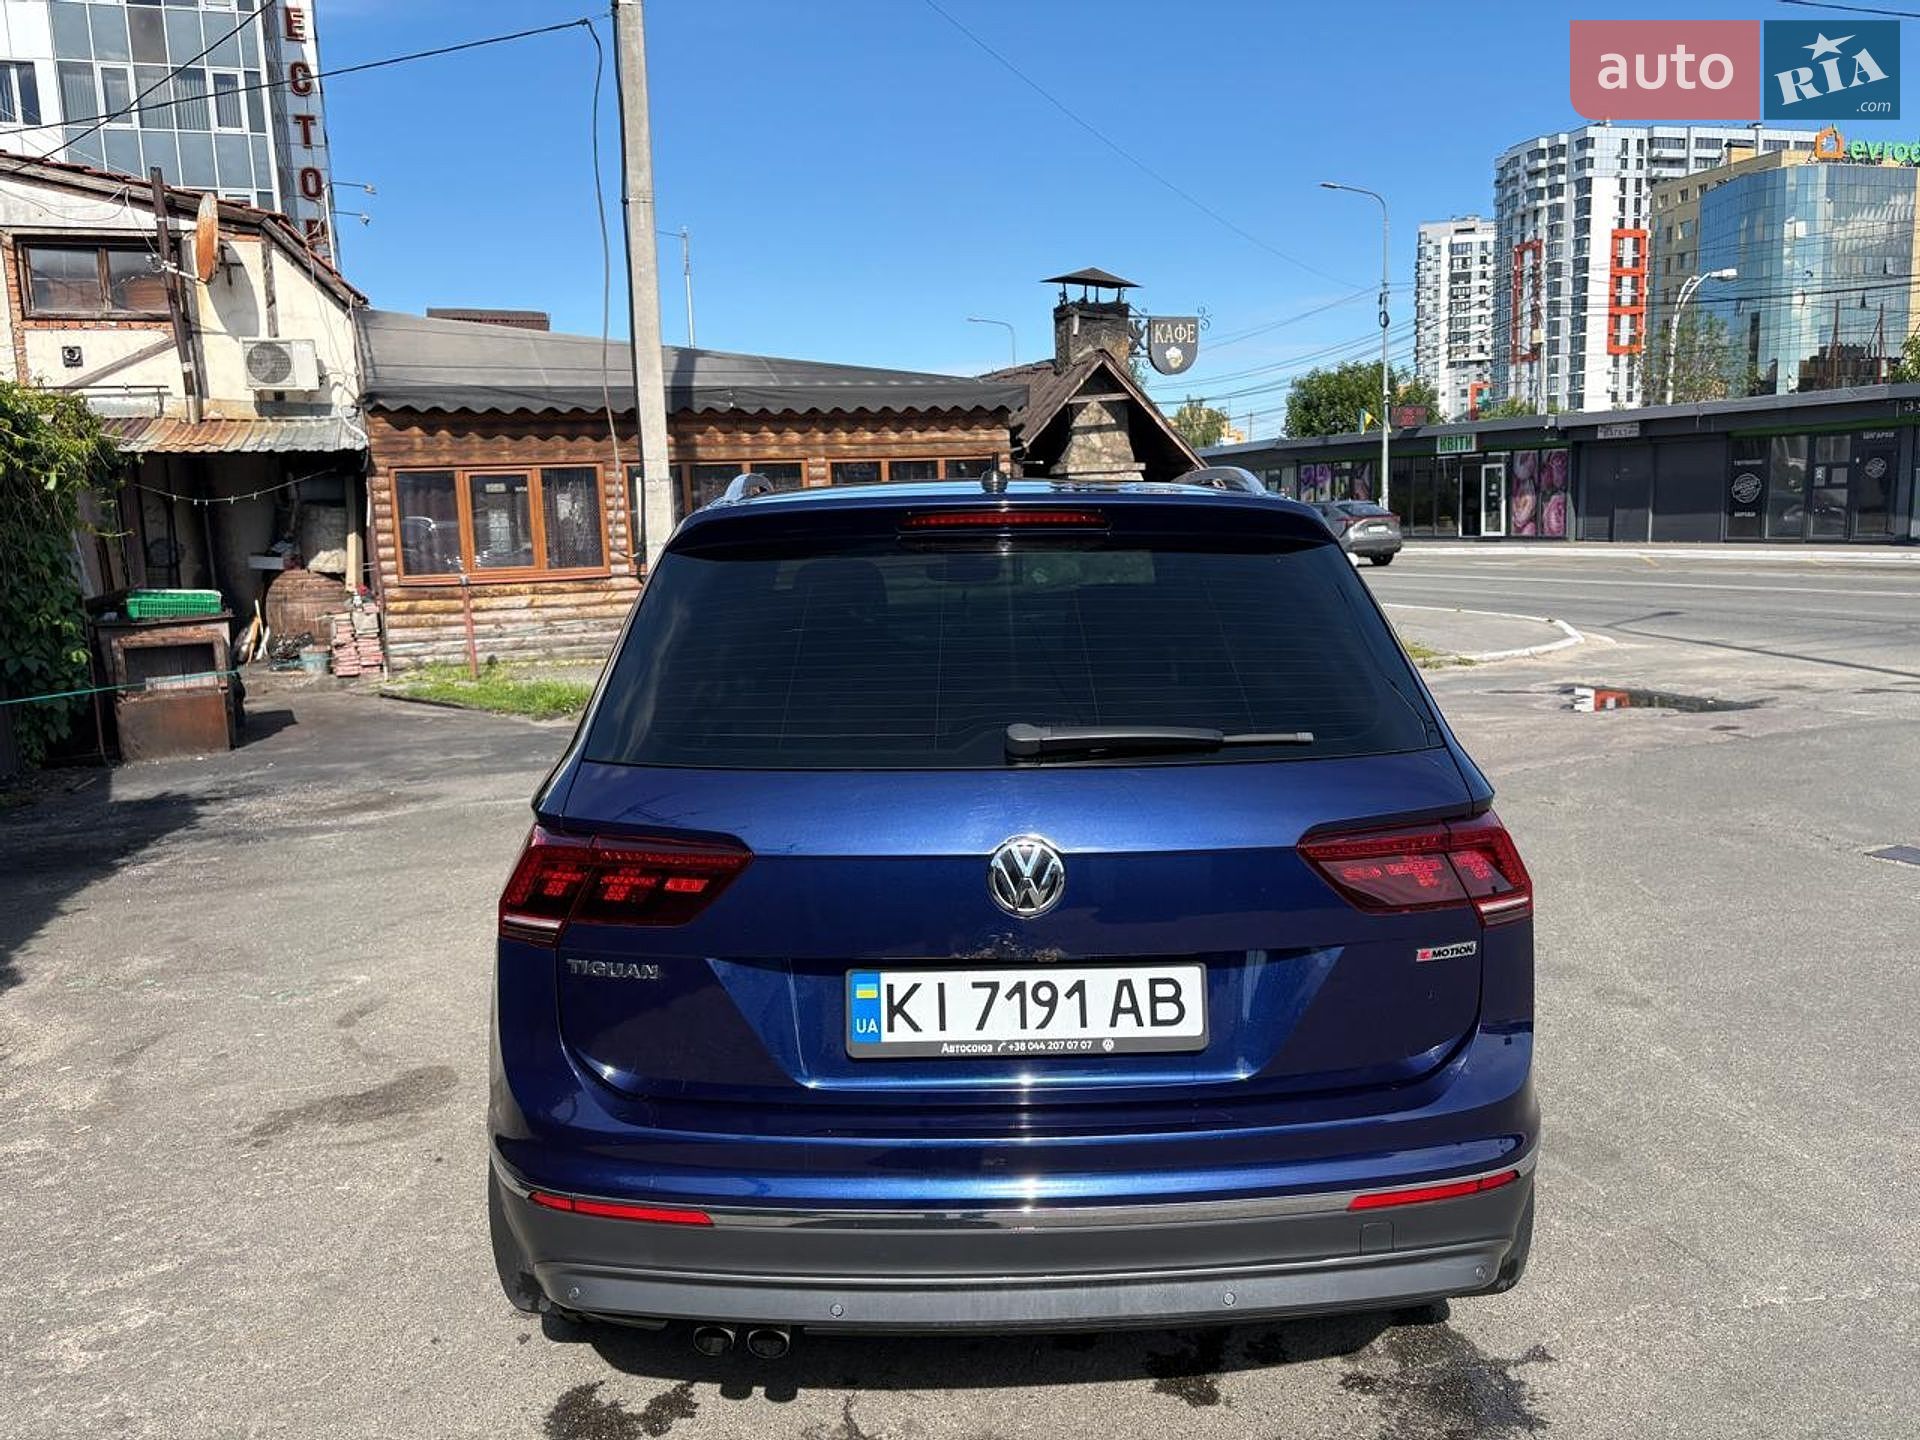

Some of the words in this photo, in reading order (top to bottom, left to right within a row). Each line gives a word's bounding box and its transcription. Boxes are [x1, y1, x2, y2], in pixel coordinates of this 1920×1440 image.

[1154, 323, 1196, 344] КАФЕ
[566, 958, 660, 980] TIGUAN
[886, 981, 947, 1033] KI
[970, 978, 1088, 1032] 7191
[1109, 976, 1187, 1029] AB
[855, 1017, 879, 1034] UA
[940, 1042, 993, 1055] Автосоюз
[1007, 1040, 1026, 1052] +38
[1027, 1040, 1046, 1051] 044
[1047, 1039, 1065, 1051] 207
[1066, 1039, 1079, 1050] 07
[1080, 1039, 1093, 1050] 07
